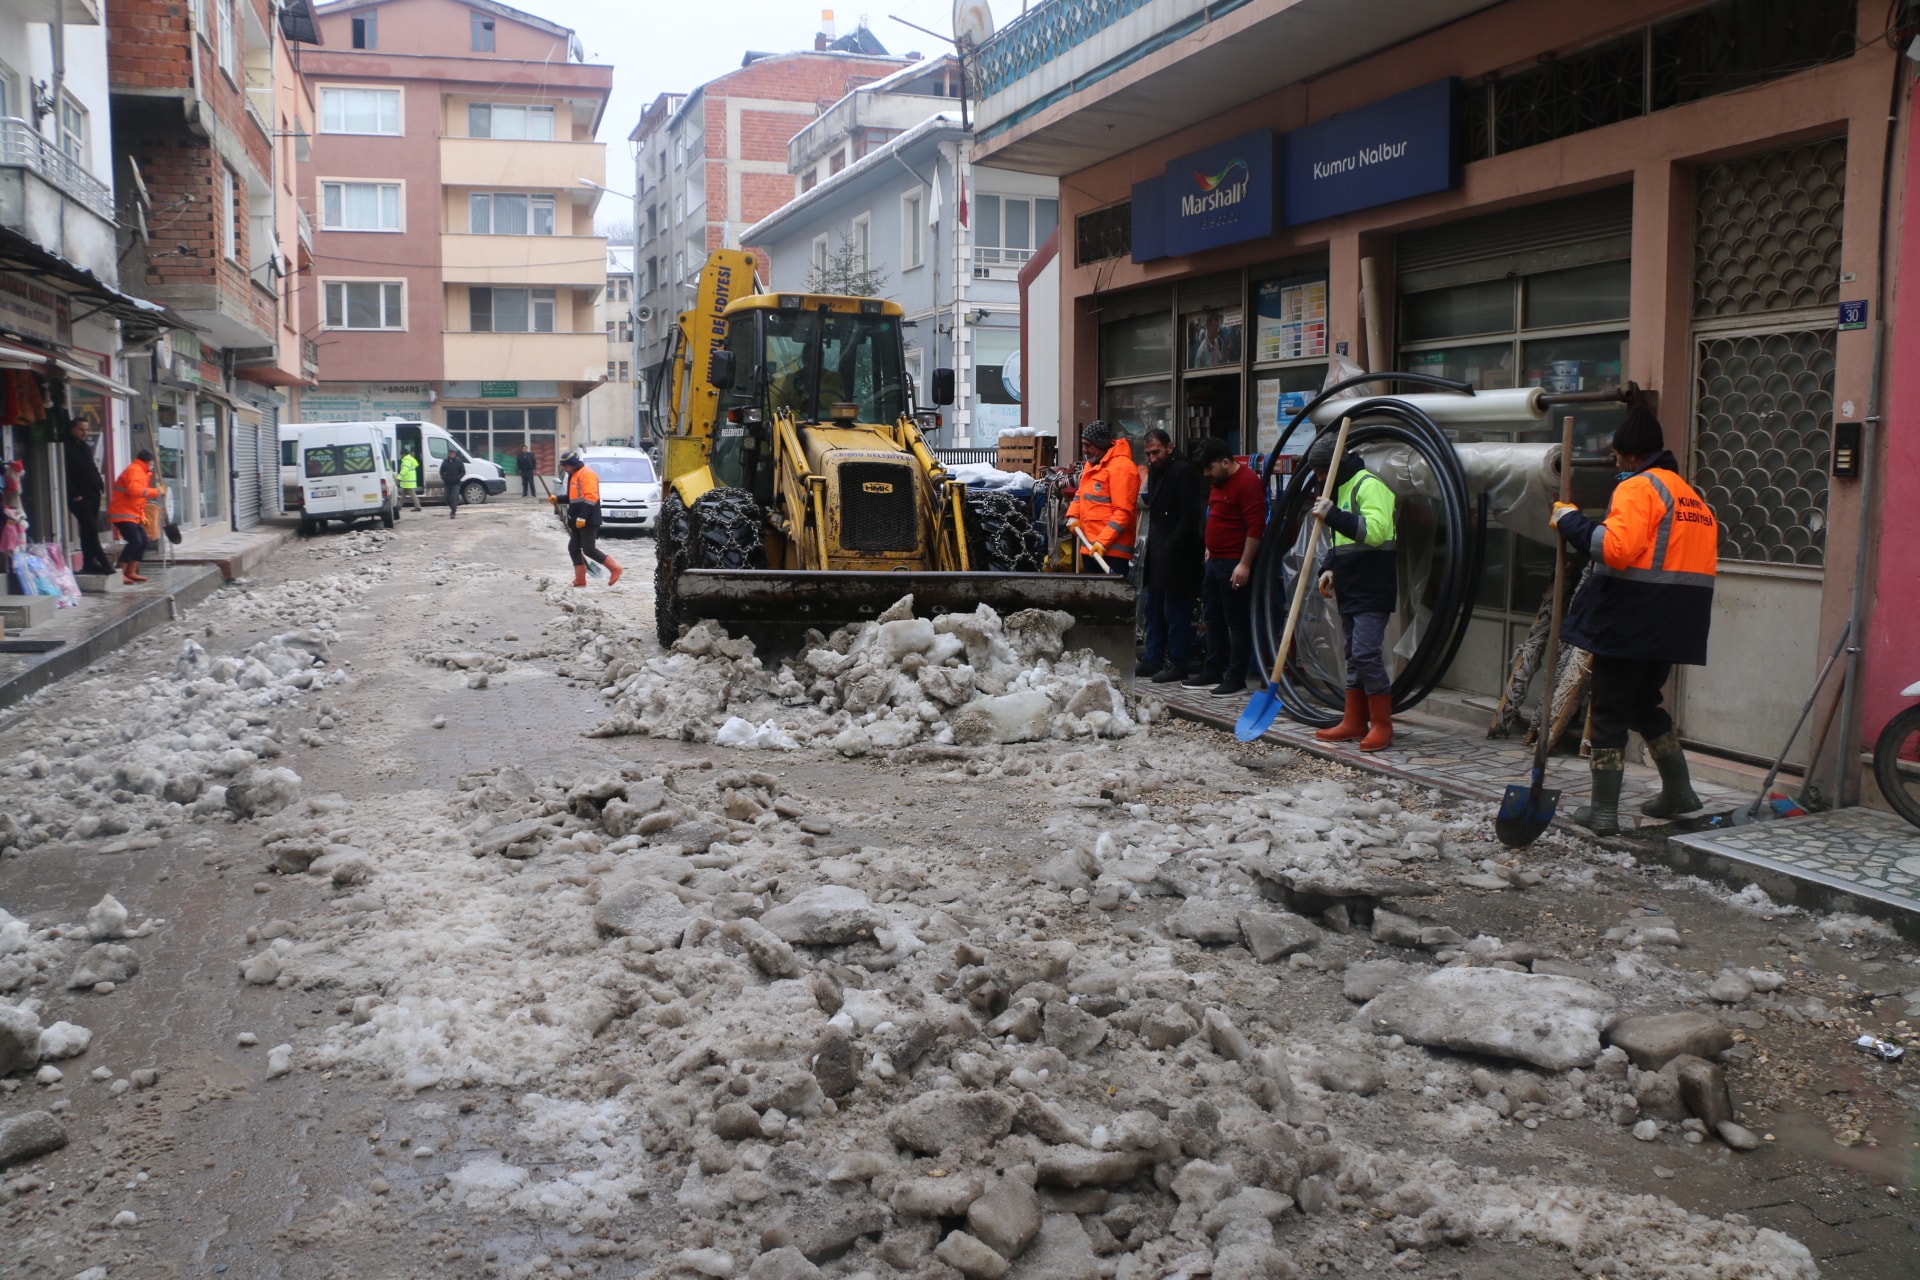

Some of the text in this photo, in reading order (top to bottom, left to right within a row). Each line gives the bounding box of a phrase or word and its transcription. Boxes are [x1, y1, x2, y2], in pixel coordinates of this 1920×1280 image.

[1313, 141, 1408, 181] Kumru Nalbur
[1181, 182, 1241, 218] Marshall
[711, 265, 732, 336] BEEDİYESİ
[1845, 309, 1859, 323] 30
[865, 484, 890, 492] HMK
